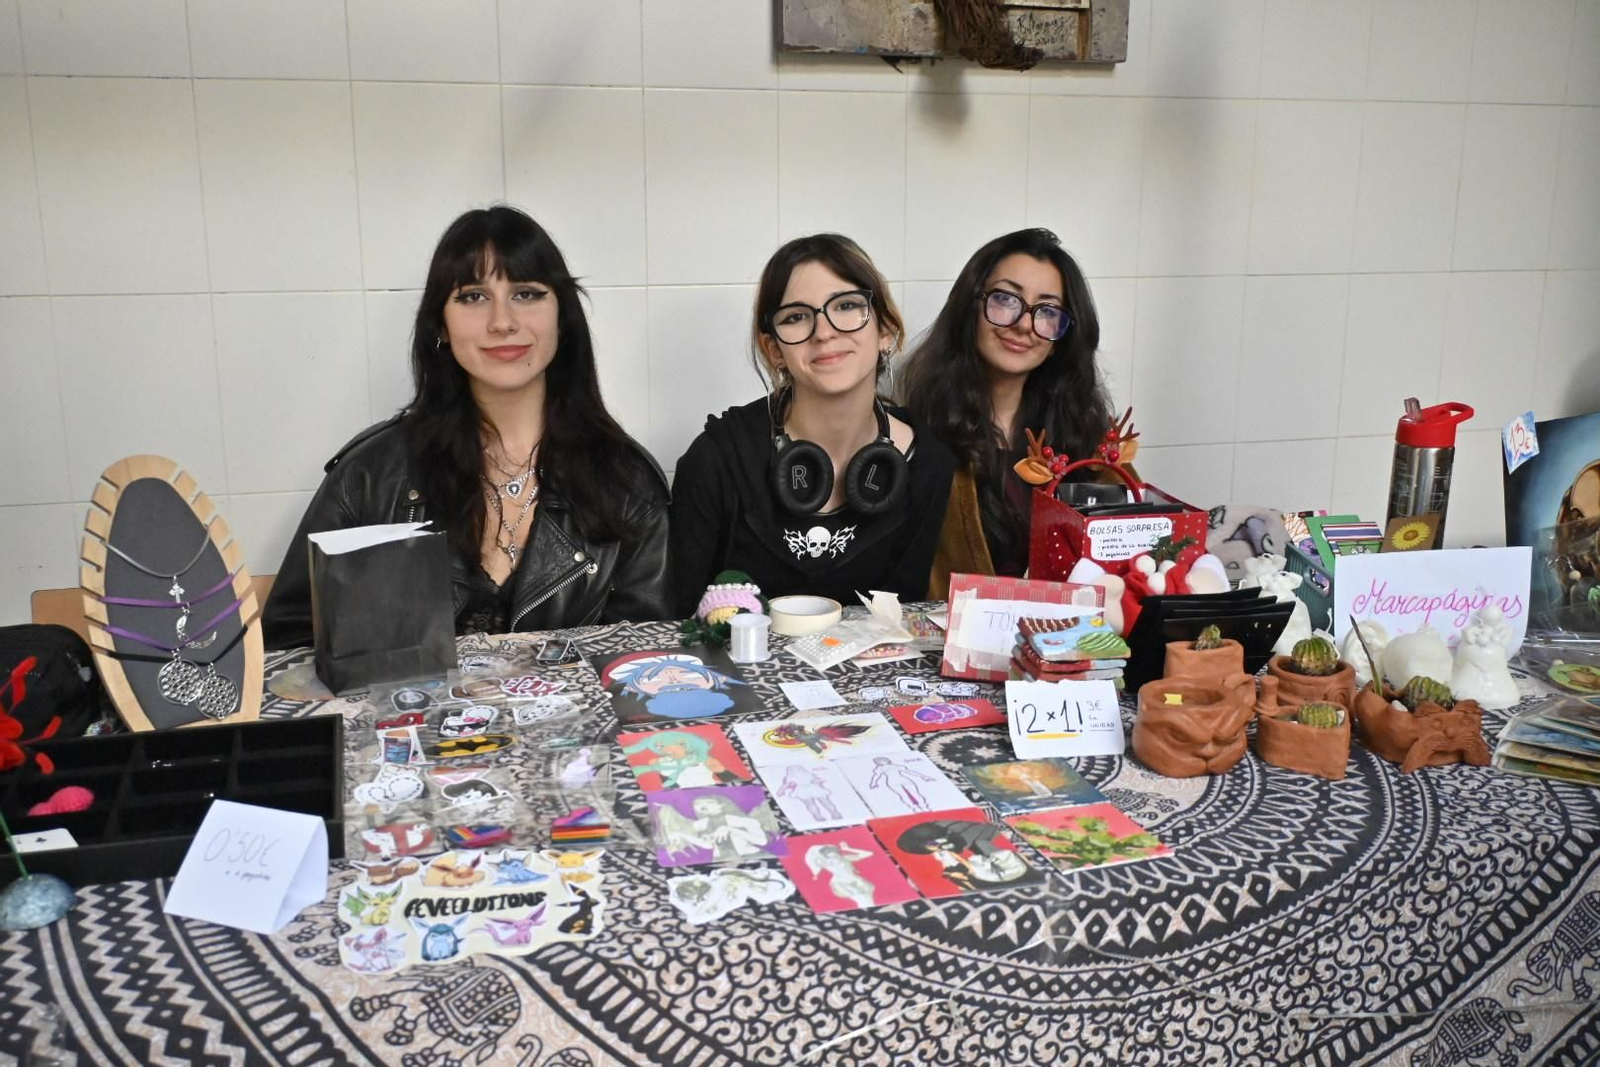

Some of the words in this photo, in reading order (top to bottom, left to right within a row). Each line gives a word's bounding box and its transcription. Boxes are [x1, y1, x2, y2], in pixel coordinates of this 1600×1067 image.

[792, 465, 808, 490] R
[865, 464, 880, 491] L
[1089, 525, 1123, 536] BOLSAS
[1126, 521, 1170, 534] SORPRESA
